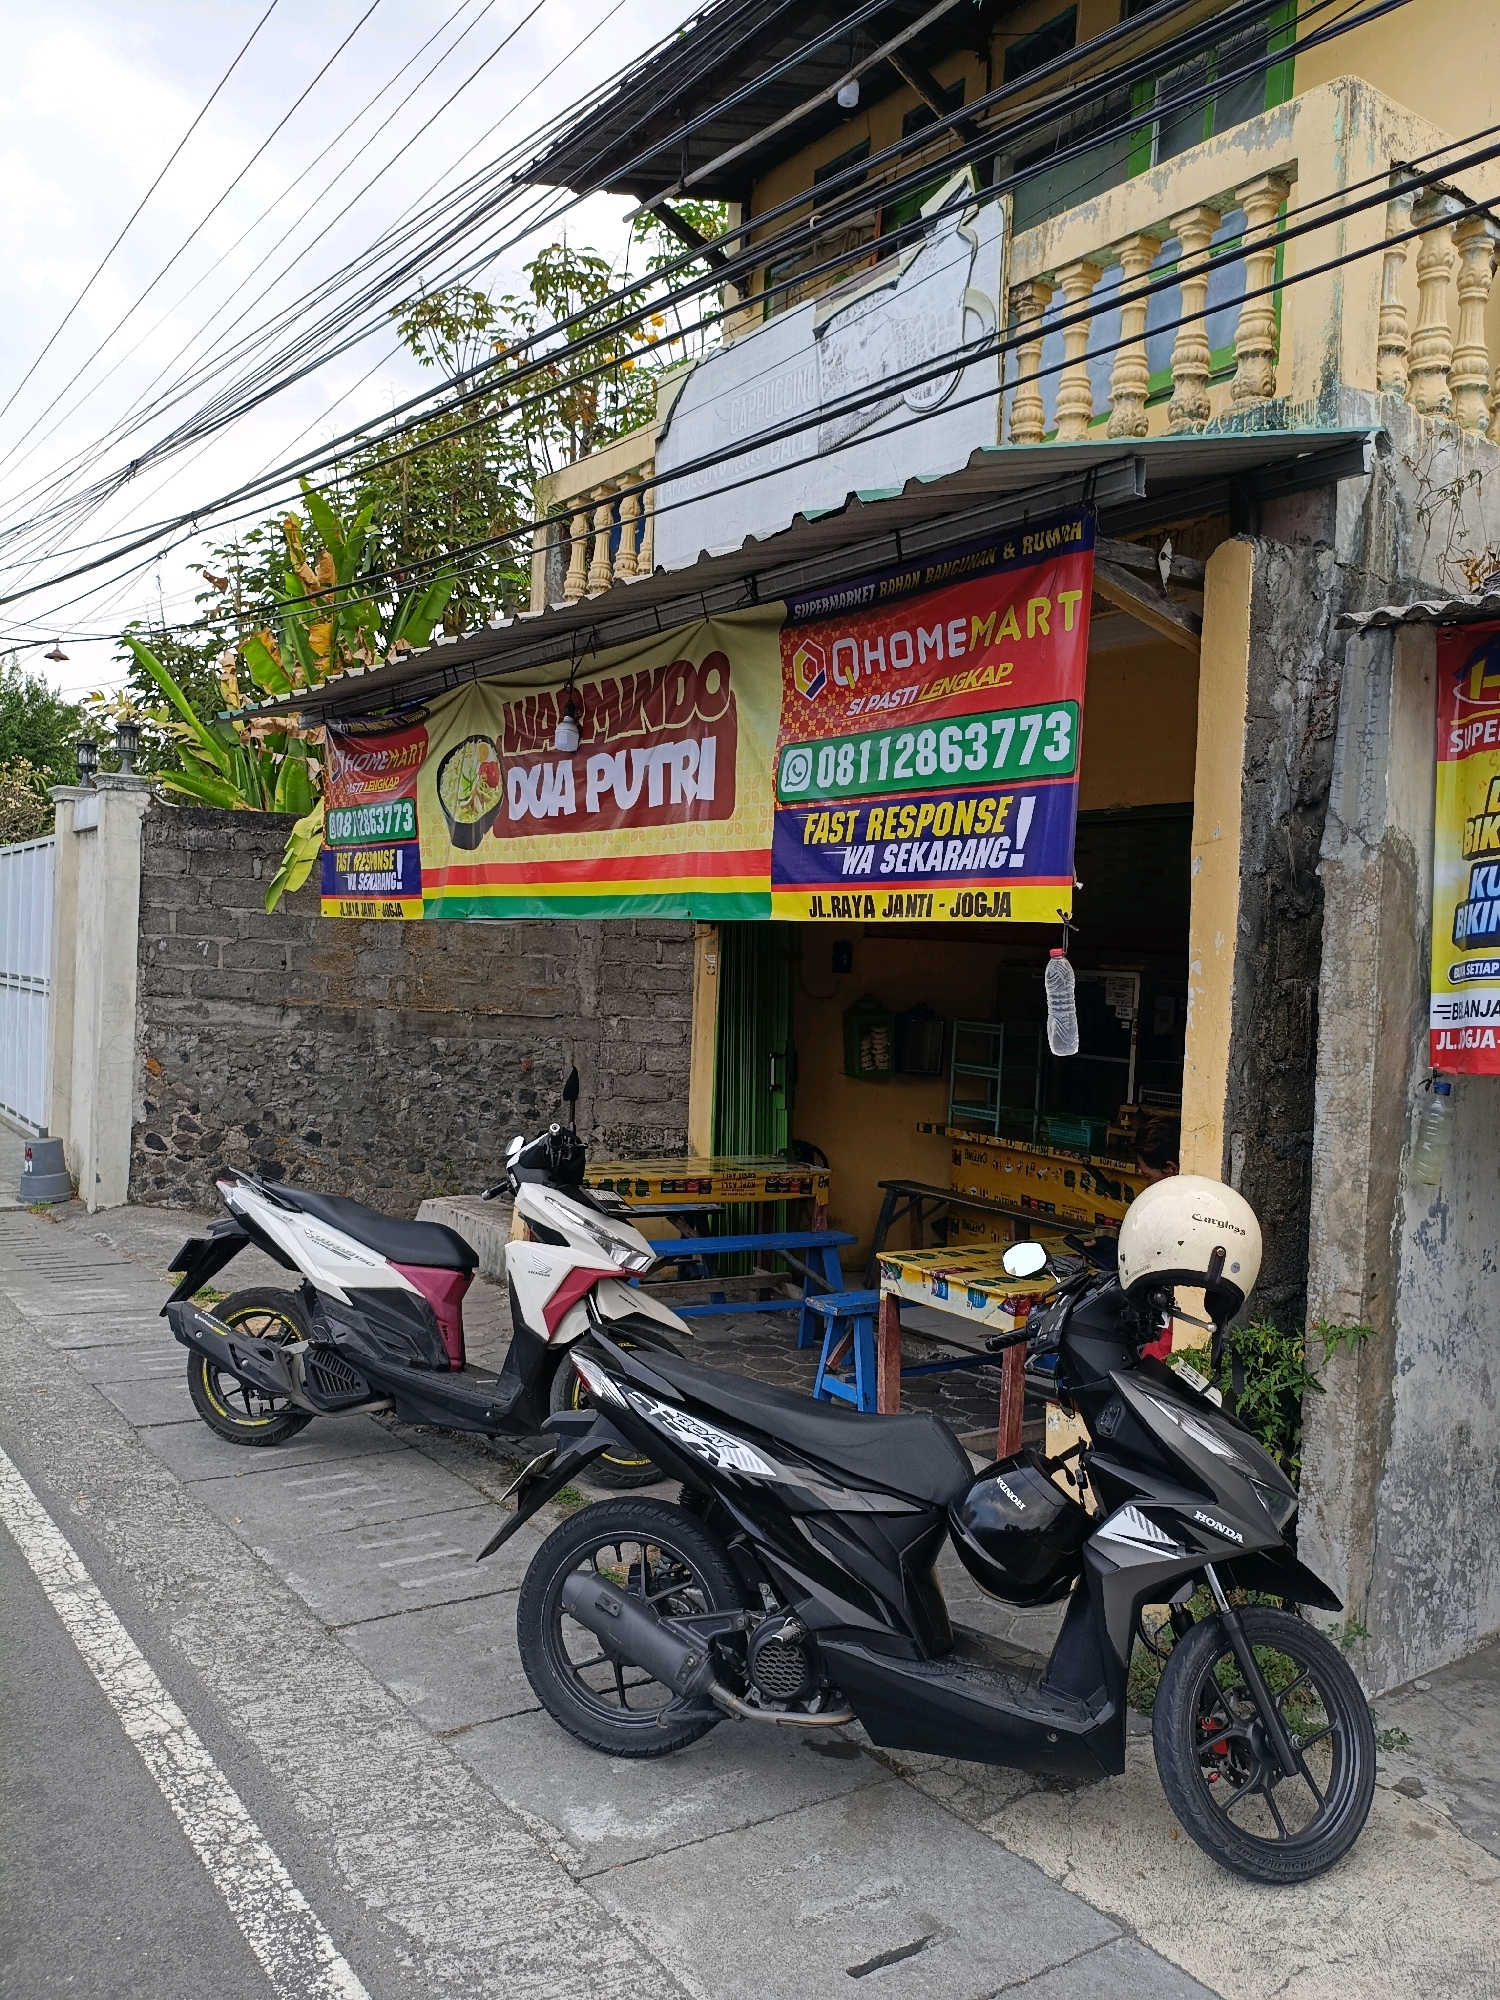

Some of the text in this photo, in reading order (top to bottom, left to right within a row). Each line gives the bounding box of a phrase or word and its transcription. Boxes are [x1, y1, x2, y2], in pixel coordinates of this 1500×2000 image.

[730, 364, 817, 435] CAPPUCCINO
[793, 520, 1083, 620] SUPERMARKET BAHAN BANGUNAN & RUMAH
[845, 662, 1014, 717] SI PASTI LENGKAP
[816, 710, 1073, 789] 08112863773
[1449, 718, 1500, 753] SUPE
[363, 776, 400, 792] LENGKAP
[507, 735, 718, 821] DUA PUTRI
[803, 795, 1014, 846] FAST RESPONSE
[841, 845, 875, 875] WA
[808, 893, 877, 919] JL.RAYA
[881, 892, 934, 918] JANTI
[949, 891, 1012, 918] JOGJA
[1466, 962, 1500, 976] SETIAP
[996, 1475, 1027, 1511] HONDA
[1193, 1510, 1244, 1545] HONDA
